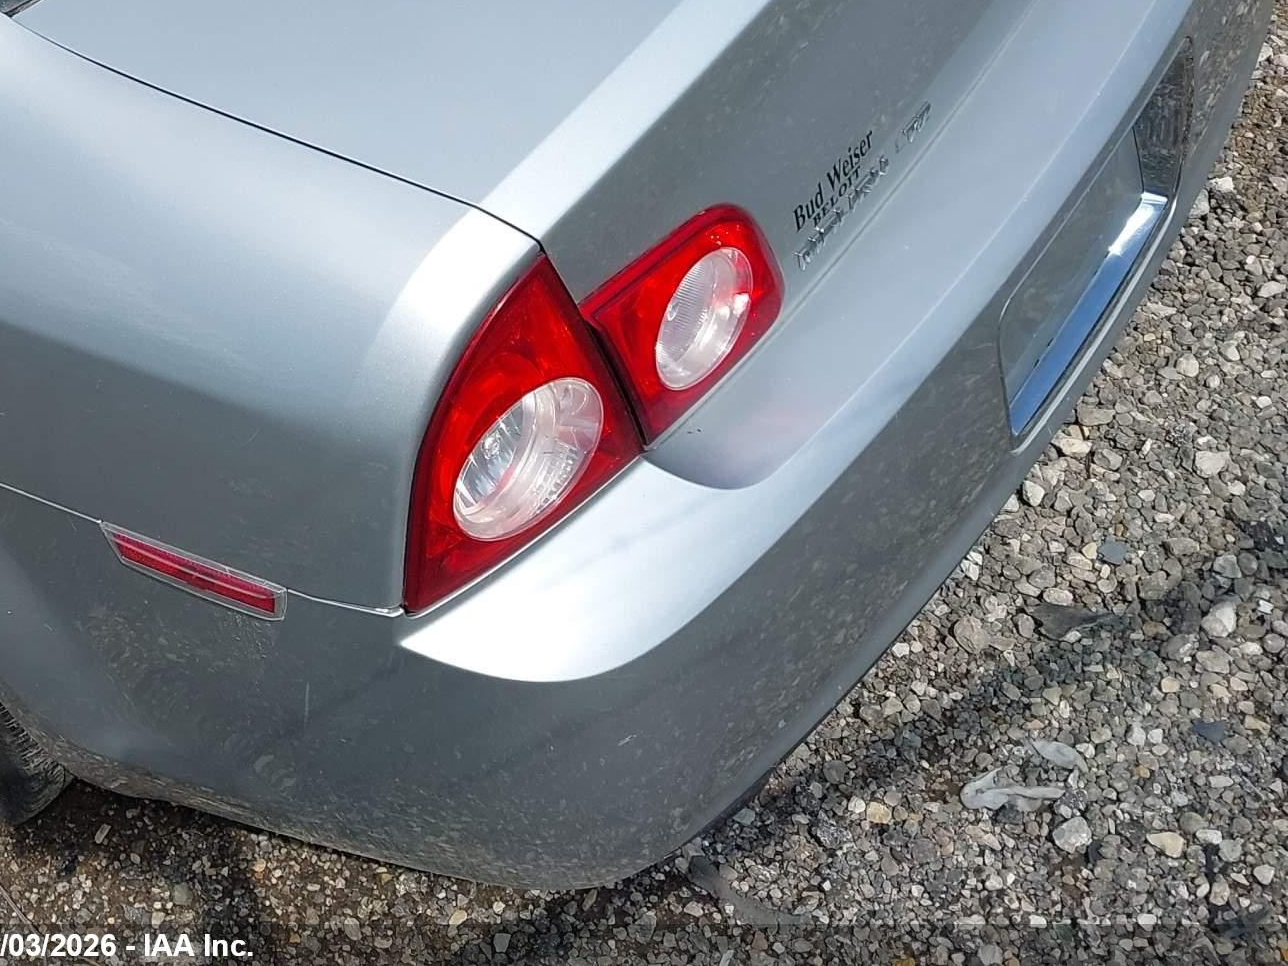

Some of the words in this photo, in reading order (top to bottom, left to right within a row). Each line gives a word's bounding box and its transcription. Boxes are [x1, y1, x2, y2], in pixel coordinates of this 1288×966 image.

[792, 182, 824, 233] Bud
[826, 130, 873, 191] Weiser
[812, 165, 861, 226] BELOIT
